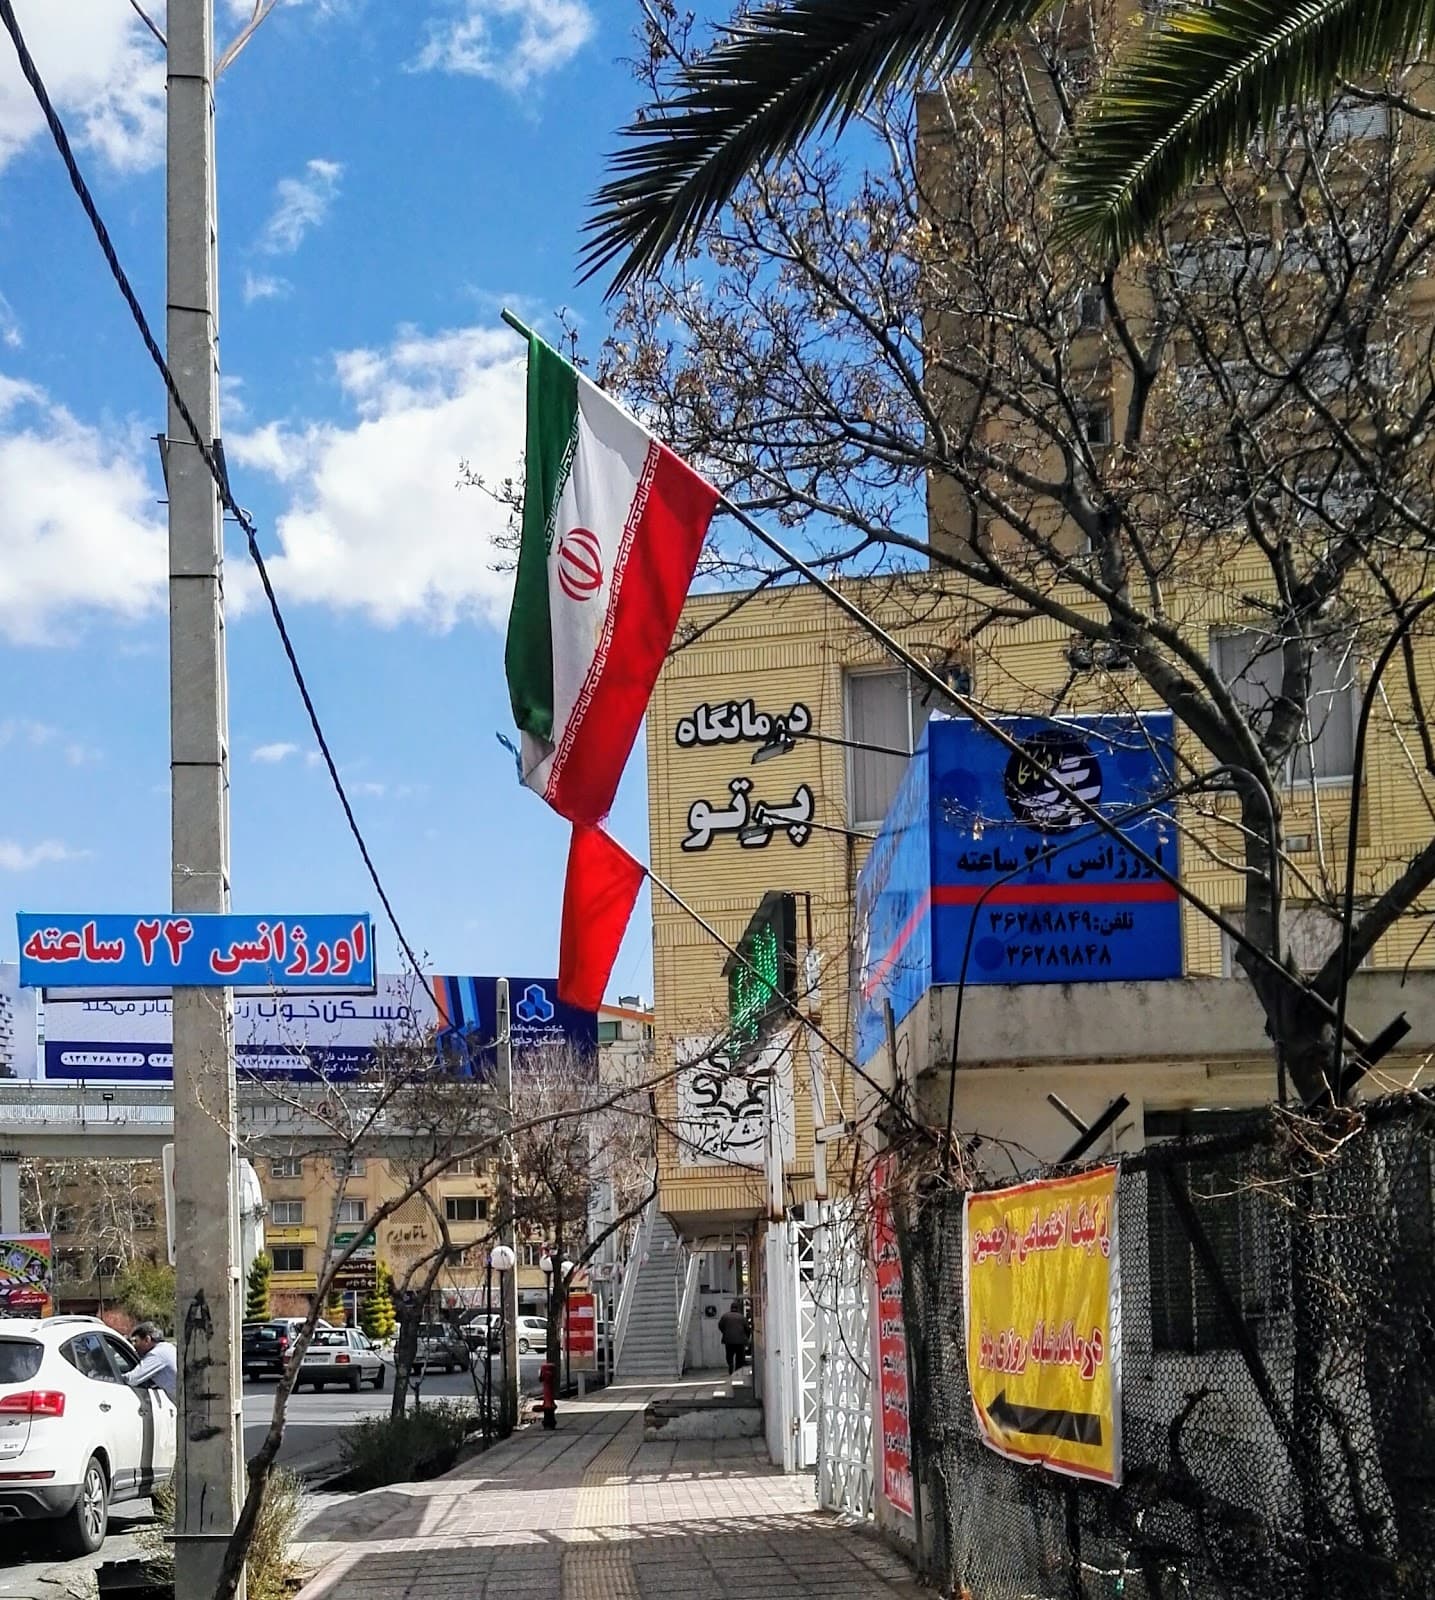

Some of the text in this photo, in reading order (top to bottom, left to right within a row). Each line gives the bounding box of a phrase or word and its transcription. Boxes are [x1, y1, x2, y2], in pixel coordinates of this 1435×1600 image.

[681, 777, 815, 851] پرتو
[957, 845, 1018, 871] ساعته
[1067, 845, 1163, 878] اورژانس
[24, 918, 366, 976] اورژانس ۲۴ ساعته
[257, 999, 320, 1022] خوب
[323, 1000, 410, 1023] مسکن
[511, 1036, 532, 1047] جنو
[1019, 1204, 1070, 1264] اختصاصی
